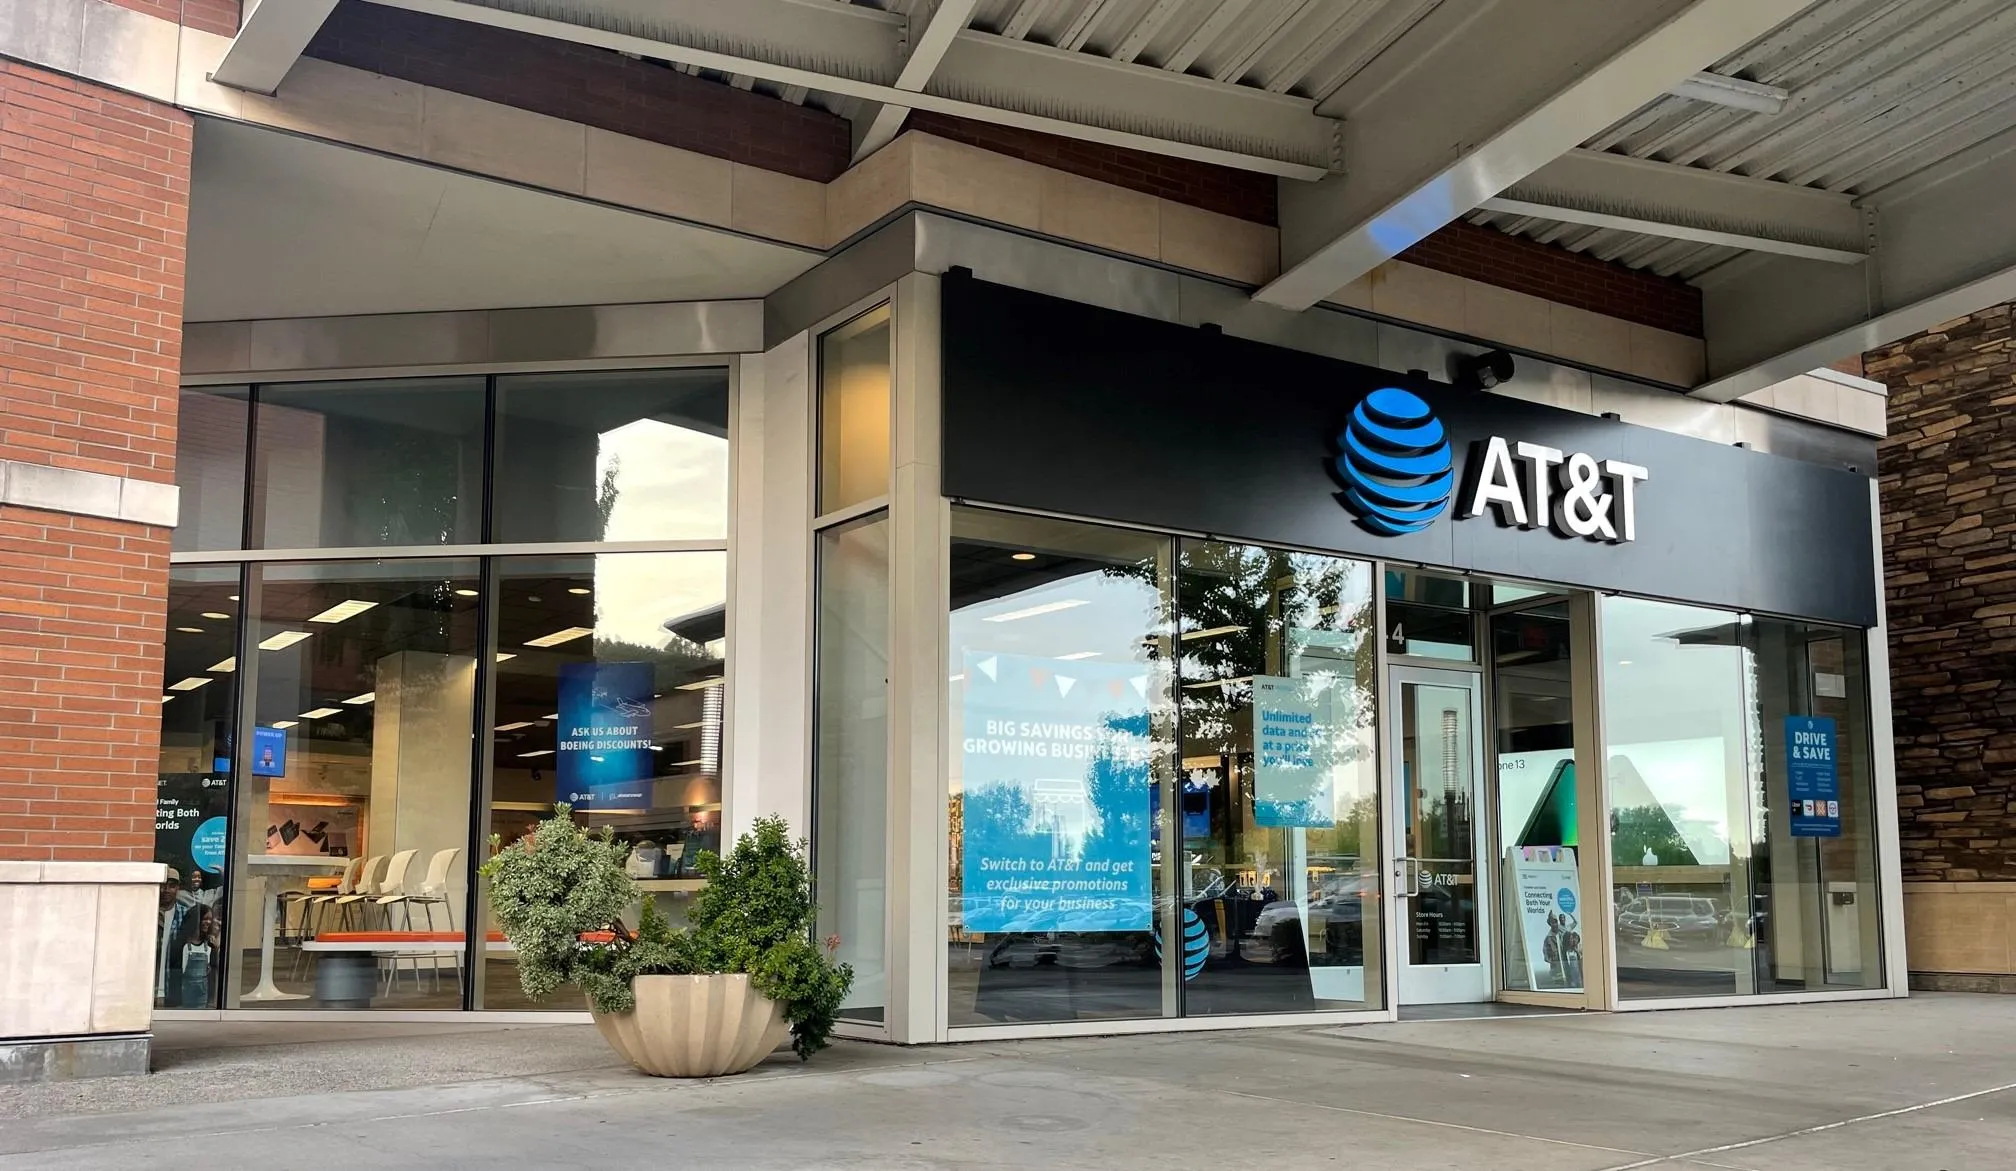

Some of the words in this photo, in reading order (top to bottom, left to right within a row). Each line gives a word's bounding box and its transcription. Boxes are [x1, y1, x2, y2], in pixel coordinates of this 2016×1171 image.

[1467, 436, 1649, 541] AT&T
[1387, 622, 1404, 645] 4
[1263, 710, 1312, 723] Unlimited
[572, 728, 590, 736] ASK
[592, 728, 604, 736] US
[607, 726, 638, 735] ABOUT
[987, 720, 1016, 735] BIG
[1021, 722, 1092, 740] SAVINGS
[1263, 725, 1285, 736] data
[1289, 728, 1307, 737] and
[560, 741, 594, 750] BOEING
[597, 740, 651, 750] DISCOUNTS!
[1263, 741, 1273, 750] at
[1277, 742, 1282, 750] a
[1795, 732, 1827, 746] DRIVE
[963, 739, 1047, 757] GROWING
[1793, 746, 1800, 758] &
[1803, 747, 1830, 760] SAVE
[1515, 760, 1525, 768] 13
[156, 808, 174, 818] ting
[177, 808, 200, 817] Both
[156, 821, 180, 830] orlds
[981, 858, 1026, 871] Switch
[1030, 858, 1046, 871] to
[1048, 858, 1082, 872] AT&T
[1085, 859, 1109, 872] and
[1113, 860, 1133, 875] get
[986, 877, 1049, 890] exclusive
[1052, 878, 1128, 894] promotions
[1434, 874, 1458, 886] AT&T
[1000, 896, 1020, 913] for
[1024, 898, 1055, 912] your
[1059, 896, 1115, 910] business
